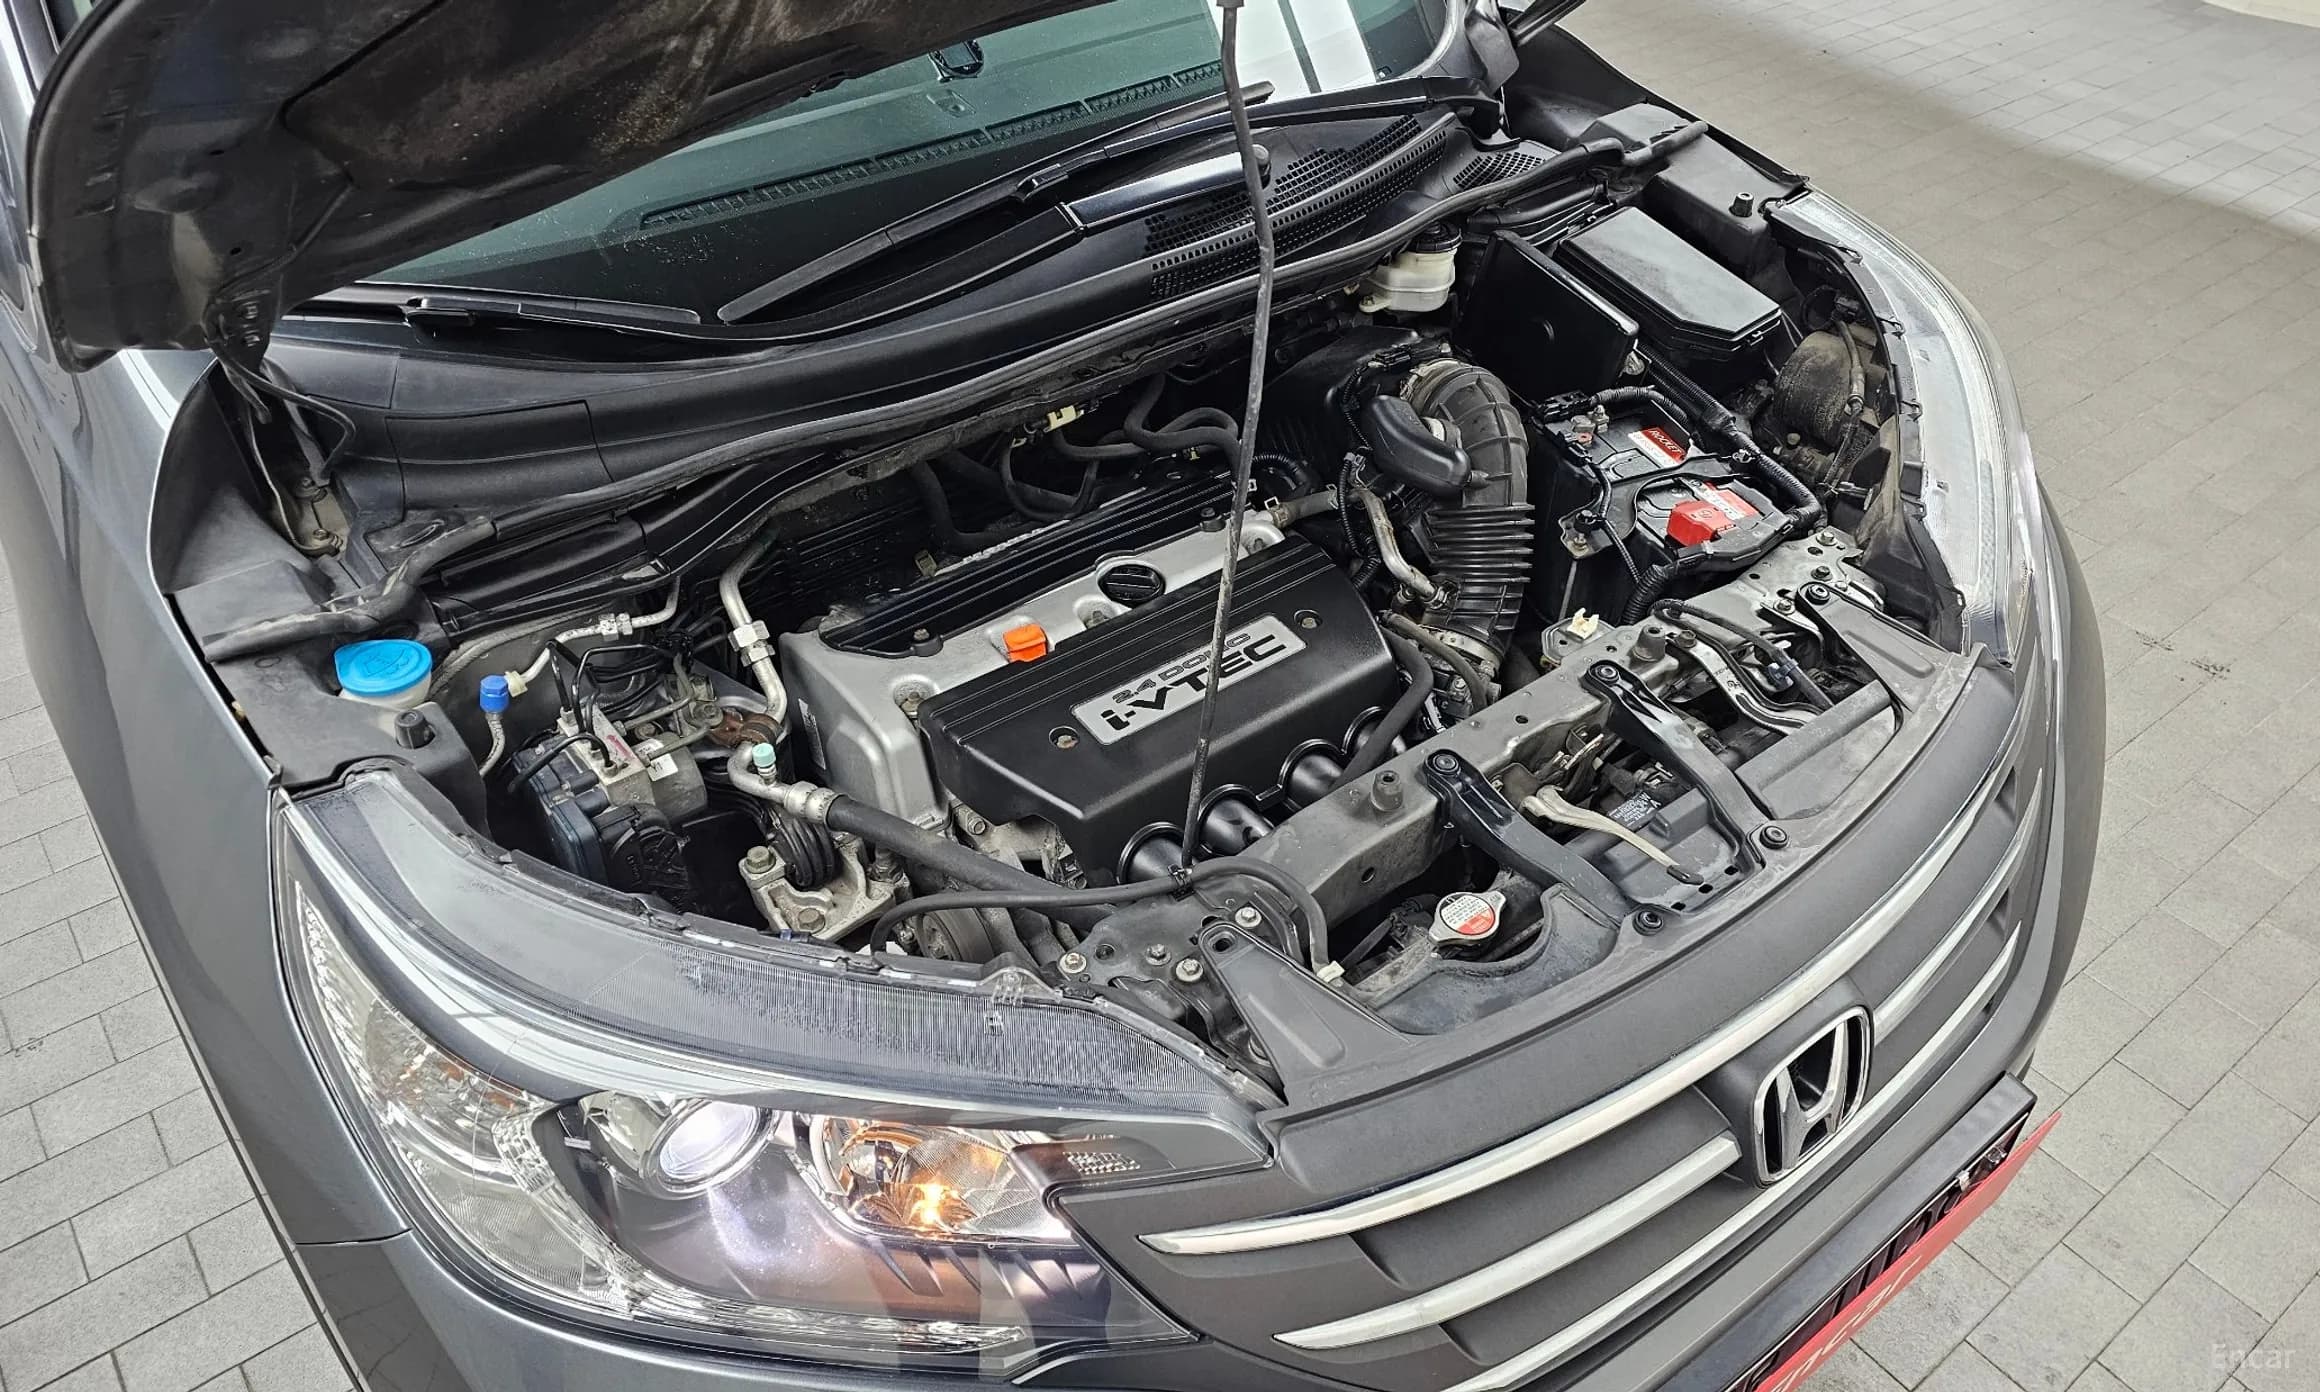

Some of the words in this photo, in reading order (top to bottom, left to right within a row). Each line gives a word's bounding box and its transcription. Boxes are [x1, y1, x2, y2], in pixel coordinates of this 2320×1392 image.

[1648, 429, 1684, 454] ROCKET
[1100, 633, 1287, 731] i-VTEC
[1112, 678, 1157, 704] 2.4
[1158, 632, 1251, 681] DOC
